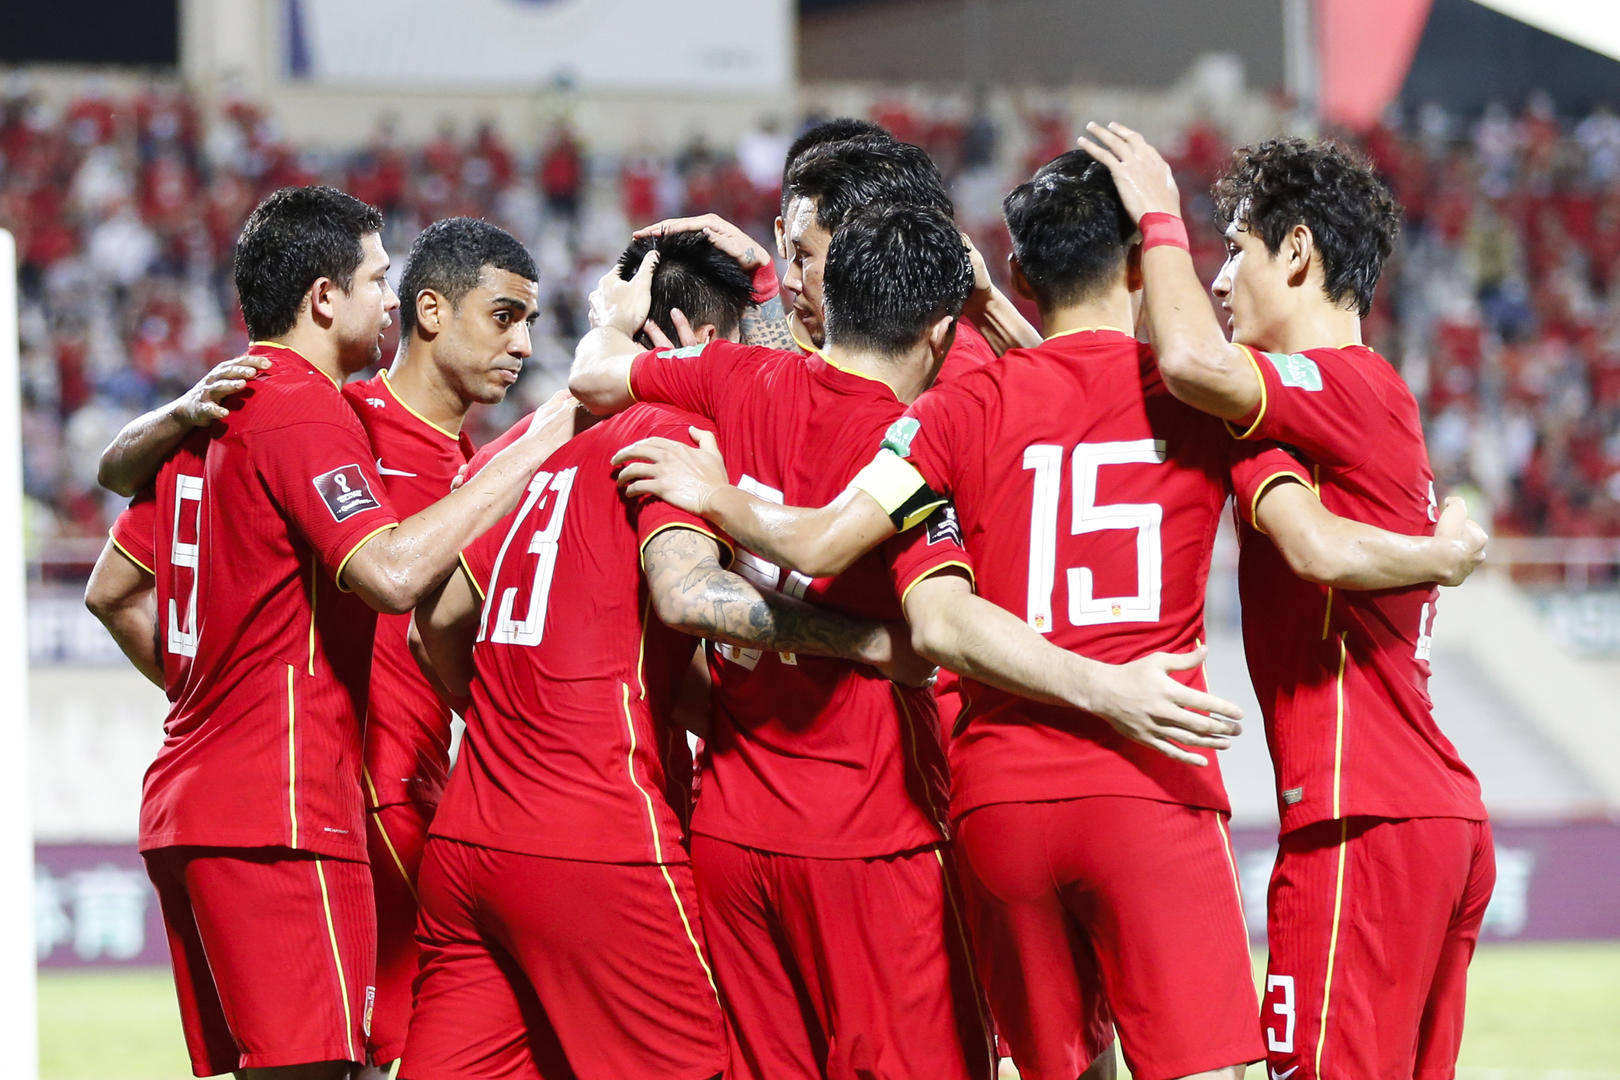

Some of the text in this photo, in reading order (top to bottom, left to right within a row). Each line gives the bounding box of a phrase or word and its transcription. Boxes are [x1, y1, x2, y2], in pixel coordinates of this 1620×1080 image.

[167, 474, 204, 658] 9
[475, 466, 578, 646] 13
[1022, 438, 1167, 634] 15
[1266, 973, 1297, 1053] 3
